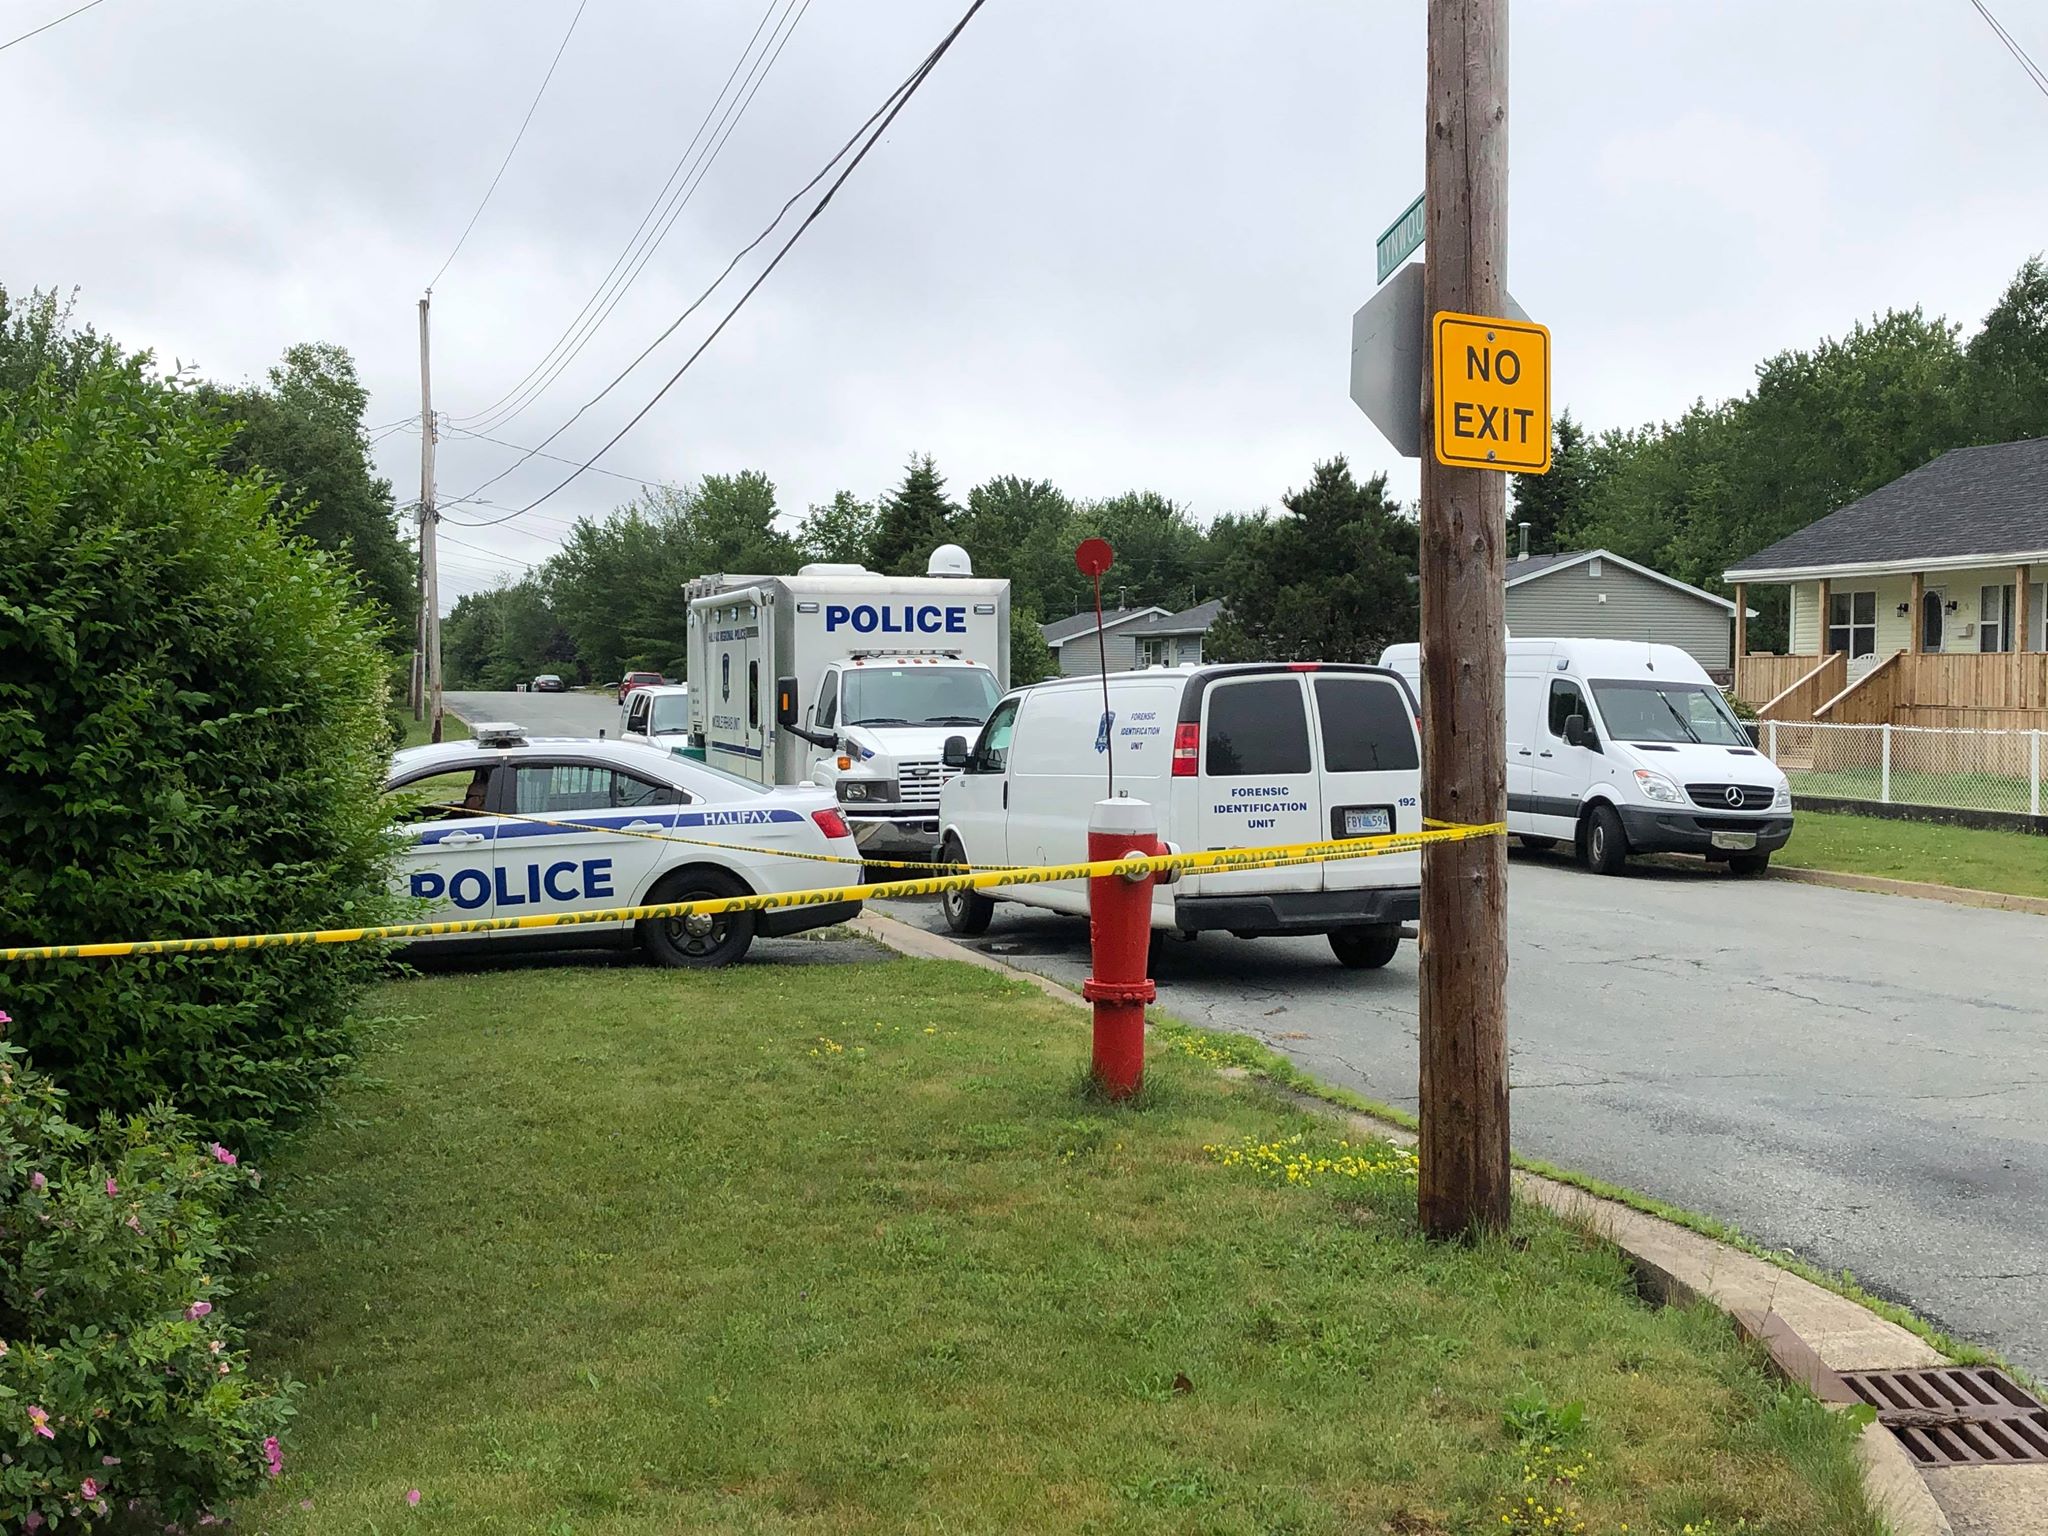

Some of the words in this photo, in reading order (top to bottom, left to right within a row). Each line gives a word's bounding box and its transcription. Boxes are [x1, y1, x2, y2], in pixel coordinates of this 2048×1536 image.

[1467, 345, 1521, 385] NO
[1454, 402, 1534, 443] EXIT
[826, 605, 967, 633] POLICE
[1131, 712, 1156, 720] FORENSIC
[1121, 727, 1160, 735] IDENTIFICATION
[1131, 742, 1143, 750] UNIT
[1231, 786, 1289, 797] FORENSIC
[1398, 797, 1416, 806] 192
[1213, 802, 1307, 814] IDENTIFICATION
[703, 810, 773, 826] HALIFAX
[1247, 818, 1276, 829] UNIT
[1346, 815, 1361, 828] FBY
[1371, 815, 1388, 827] 594
[410, 858, 615, 909] POLICE
